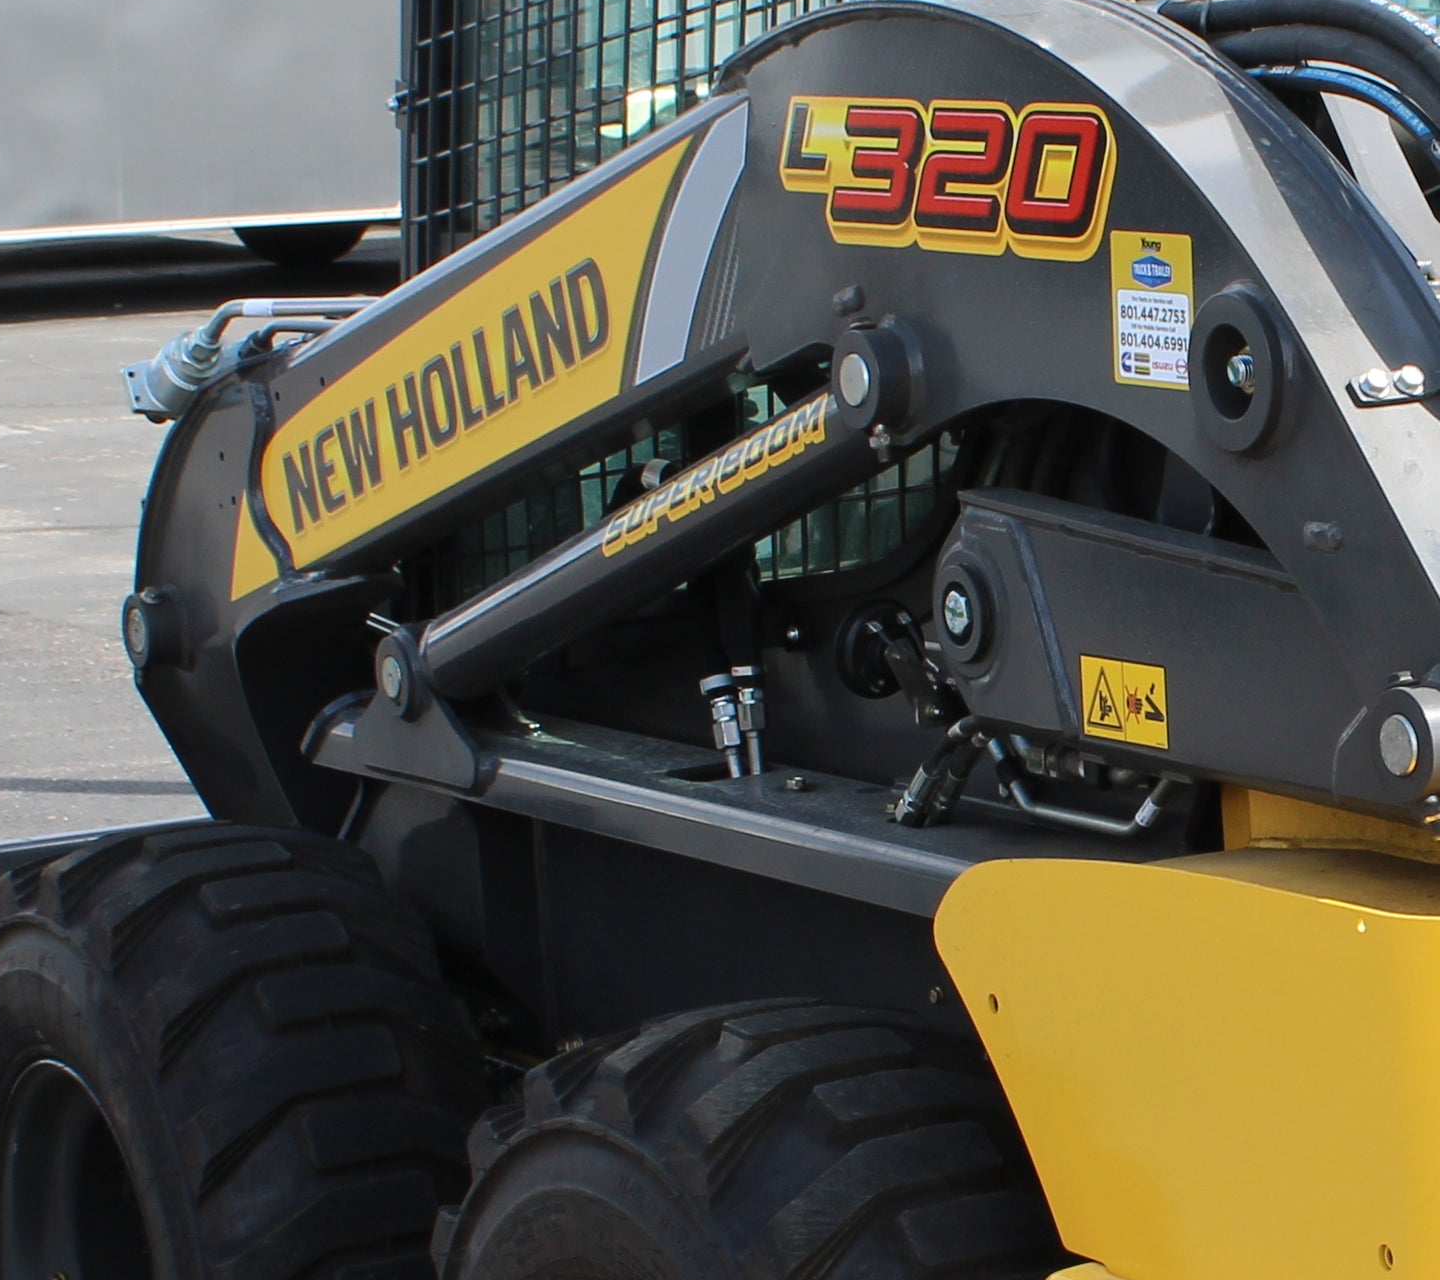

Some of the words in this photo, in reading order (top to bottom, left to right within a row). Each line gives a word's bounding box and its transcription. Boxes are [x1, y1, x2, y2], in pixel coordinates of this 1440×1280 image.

[779, 95, 1118, 262] L320
[282, 397, 383, 535] NEW
[385, 257, 610, 471] HOLLAND
[1120, 304, 1186, 325] 801.447.2753
[1120, 331, 1188, 352] 801.404.6991
[602, 456, 719, 558] SUPER
[717, 392, 830, 495] BOOM
